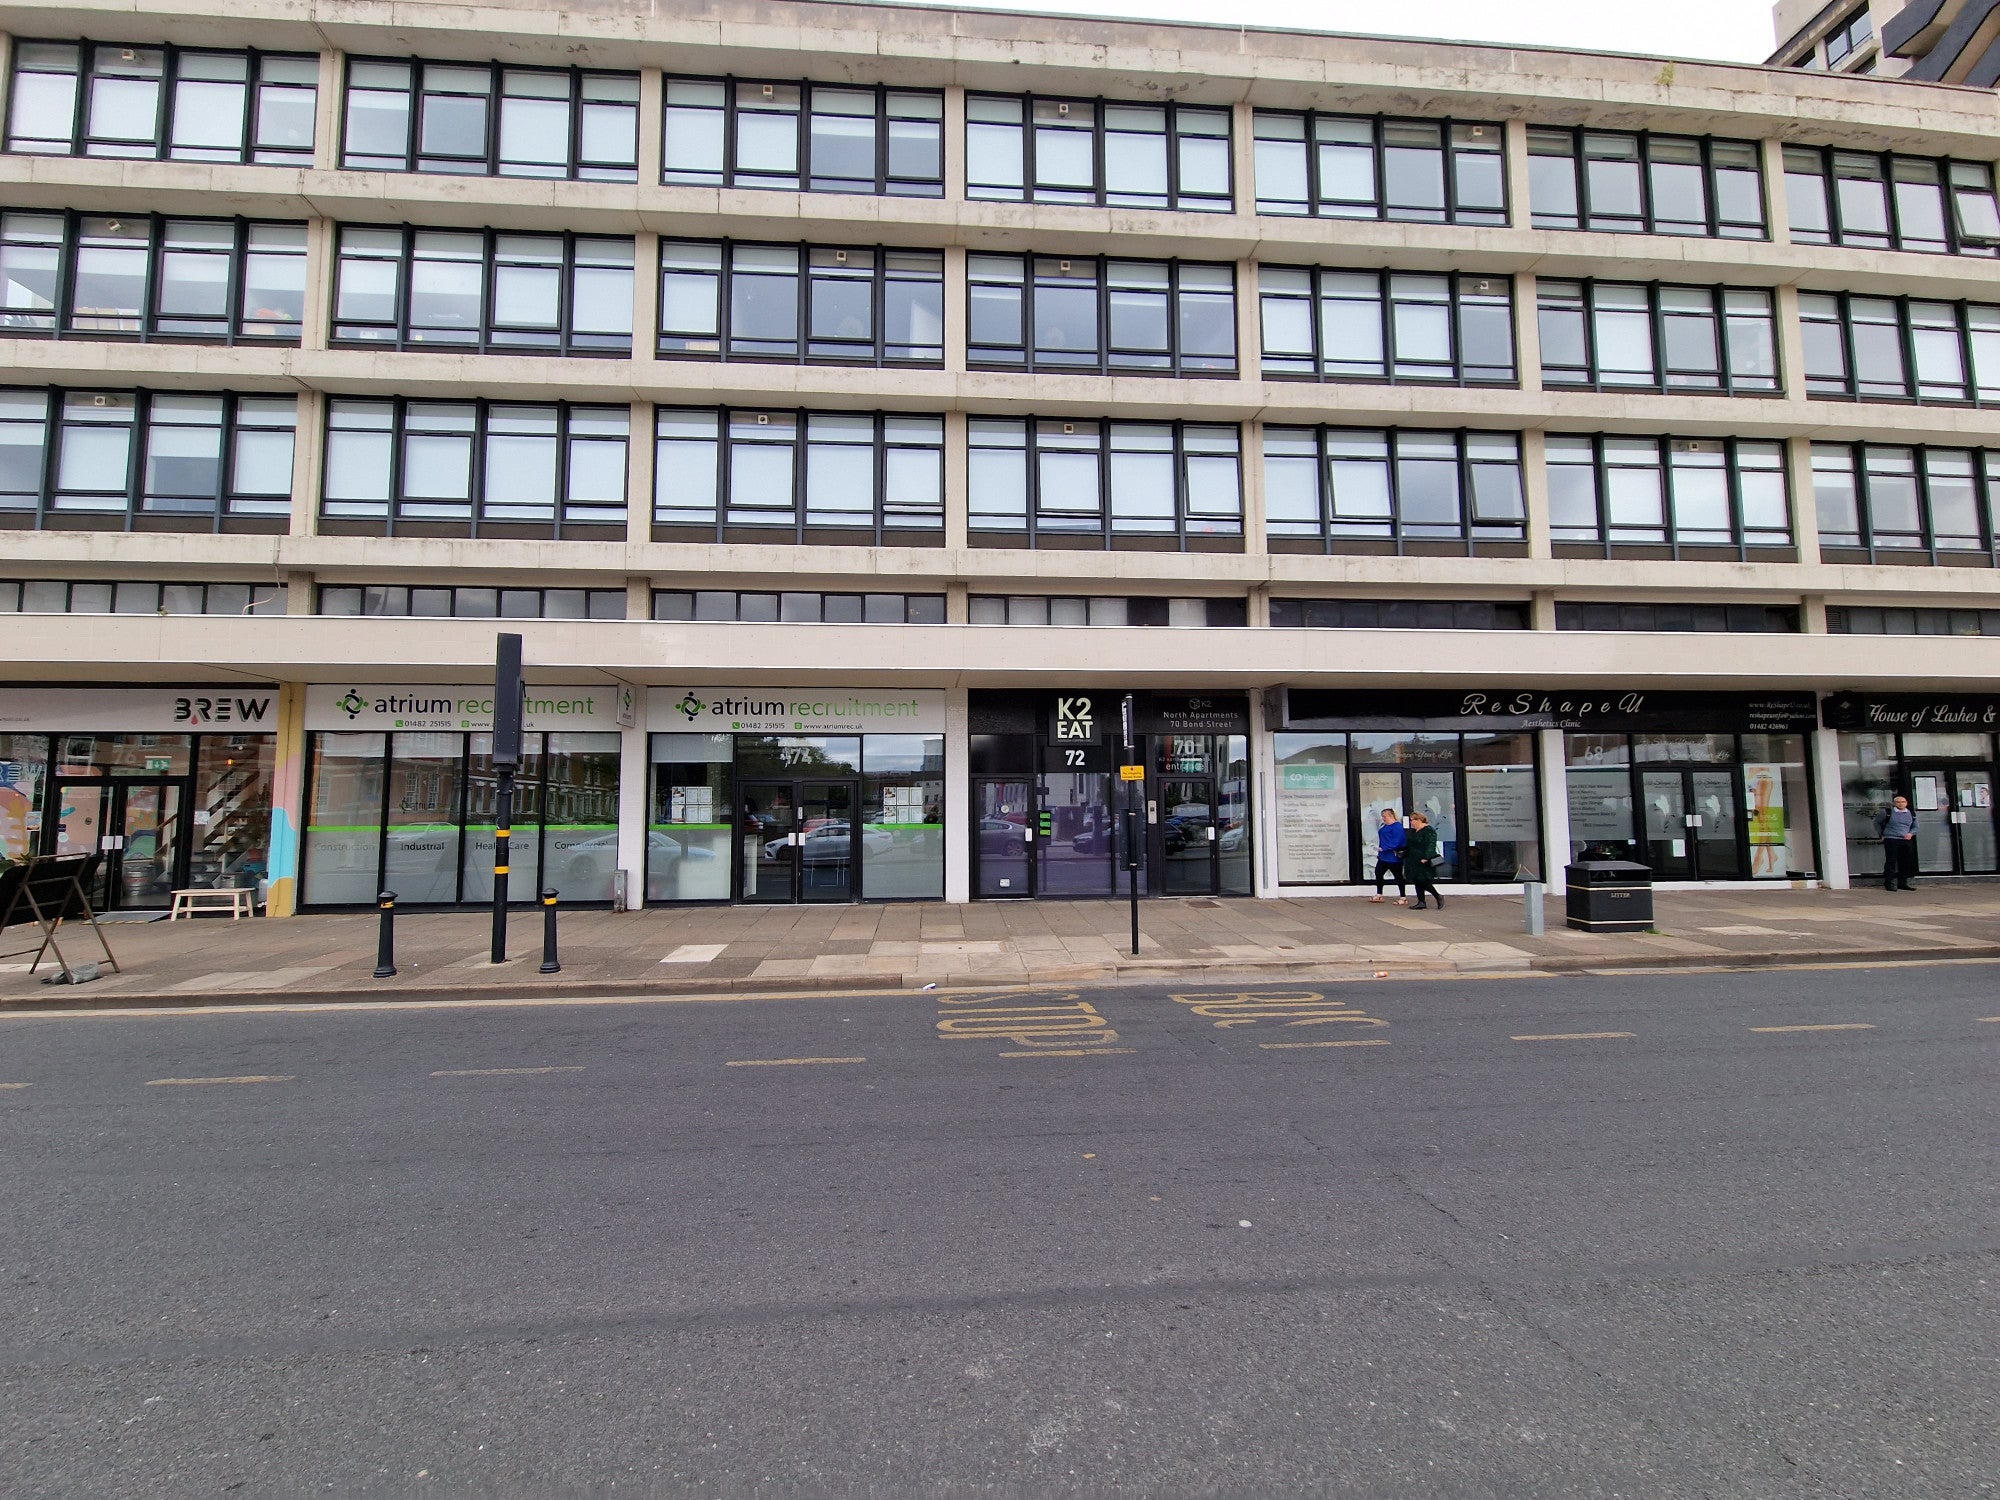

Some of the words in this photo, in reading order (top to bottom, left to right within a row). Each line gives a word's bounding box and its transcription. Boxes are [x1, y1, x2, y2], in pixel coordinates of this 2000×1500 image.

[174, 697, 271, 723] BREW
[374, 693, 452, 714] atrium
[456, 696, 594, 715] rectment
[711, 696, 785, 716] atrium
[789, 697, 919, 717] recruitment
[1058, 697, 1092, 720] K2
[1163, 711, 1187, 719] North
[1189, 711, 1239, 720] Apartments
[1869, 703, 1909, 723] House
[1911, 706, 1930, 728] of
[1931, 704, 1978, 723] Lashes
[1982, 704, 1997, 723] &
[404, 720, 427, 728] 01482
[429, 720, 452, 728] 251515
[740, 722, 762, 730] 01482
[764, 722, 785, 730] 251515
[1056, 720, 1094, 739] EAT
[1170, 720, 1180, 728] 70
[1183, 720, 1204, 728] Bond
[1206, 720, 1232, 728] Street
[1521, 719, 1559, 729] Aesthetics
[1560, 719, 1582, 729] Clinic
[1174, 739, 1195, 755] 70
[1585, 745, 1604, 761] 68
[1065, 749, 1086, 766] 72
[401, 842, 445, 851] Industrial
